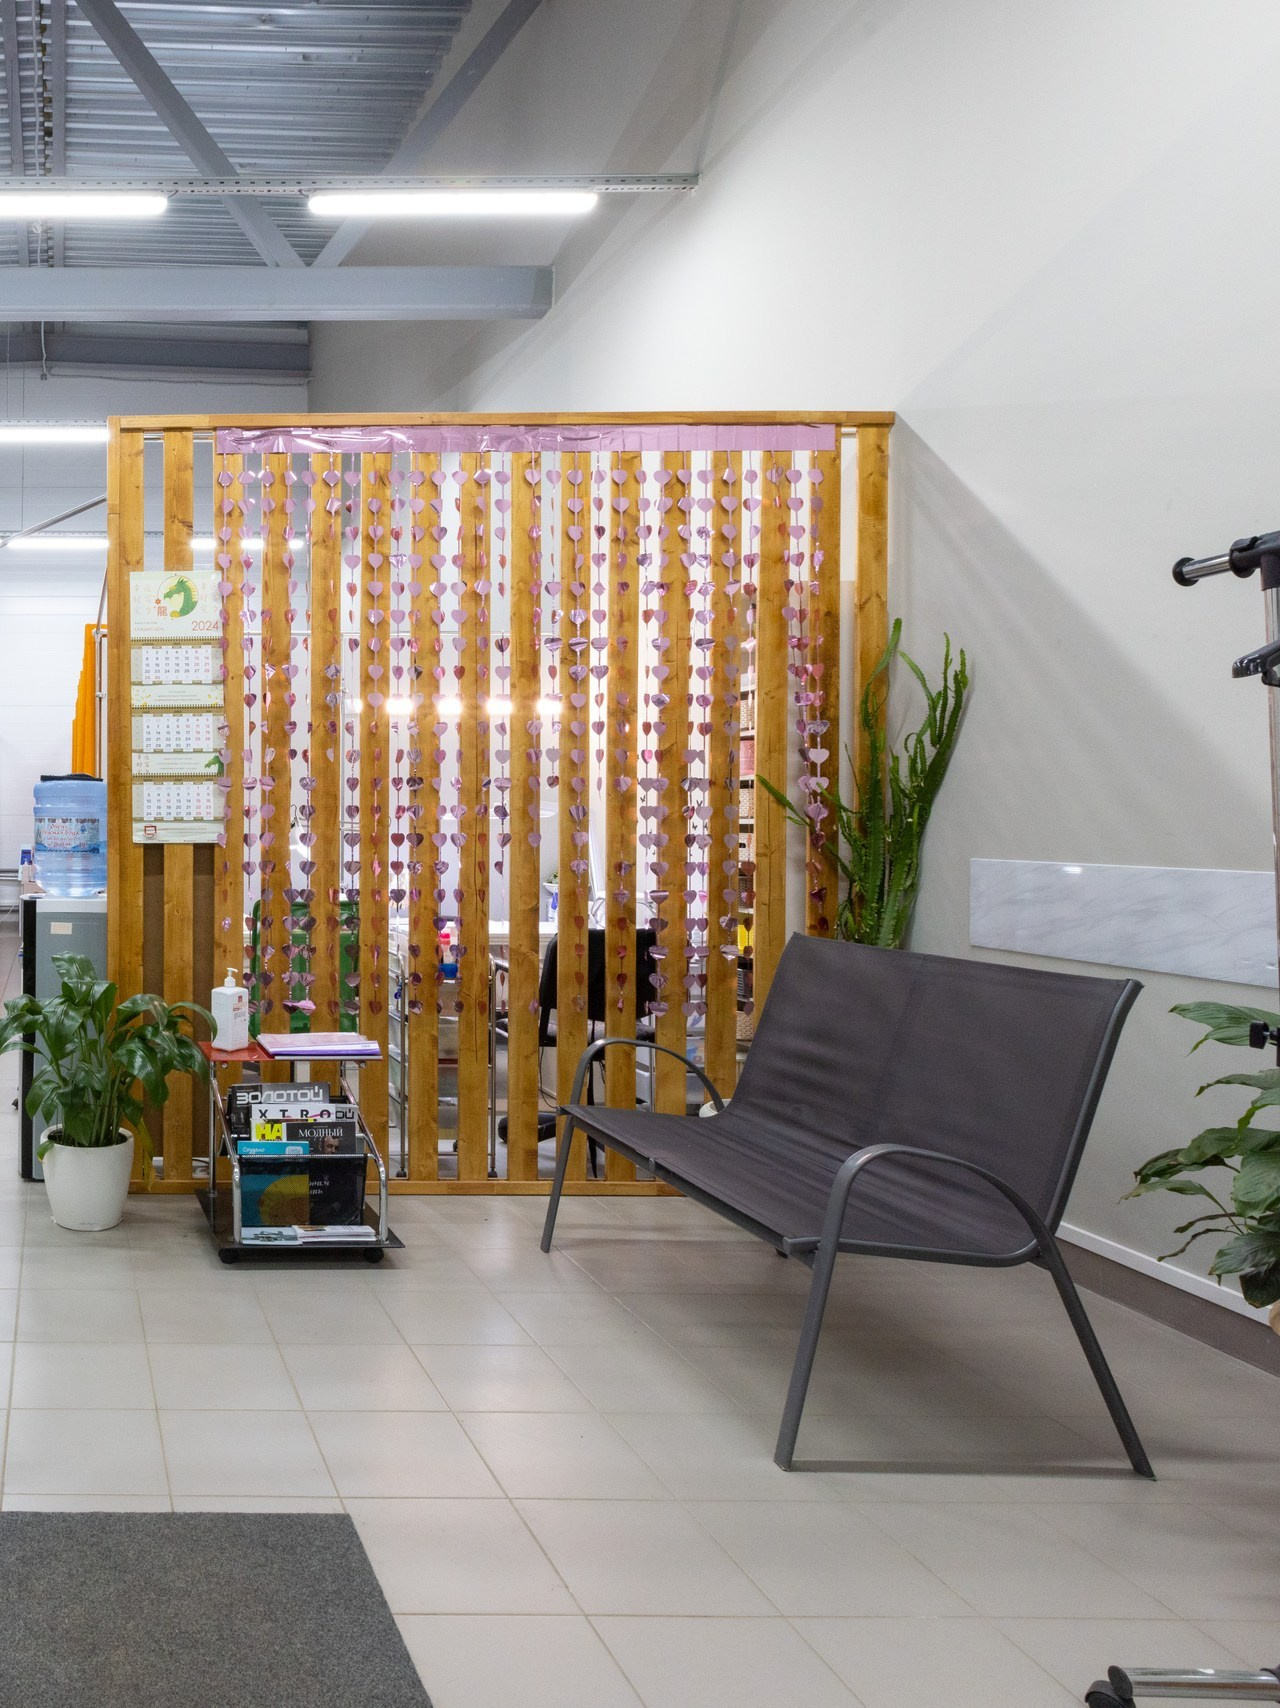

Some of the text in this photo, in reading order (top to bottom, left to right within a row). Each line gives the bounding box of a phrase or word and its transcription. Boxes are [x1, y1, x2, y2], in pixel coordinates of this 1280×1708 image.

[192, 620, 219, 631] 2024
[236, 1086, 322, 1104] ЗОЛОТОЙ
[298, 1126, 342, 1138] МОДНЫЙ
